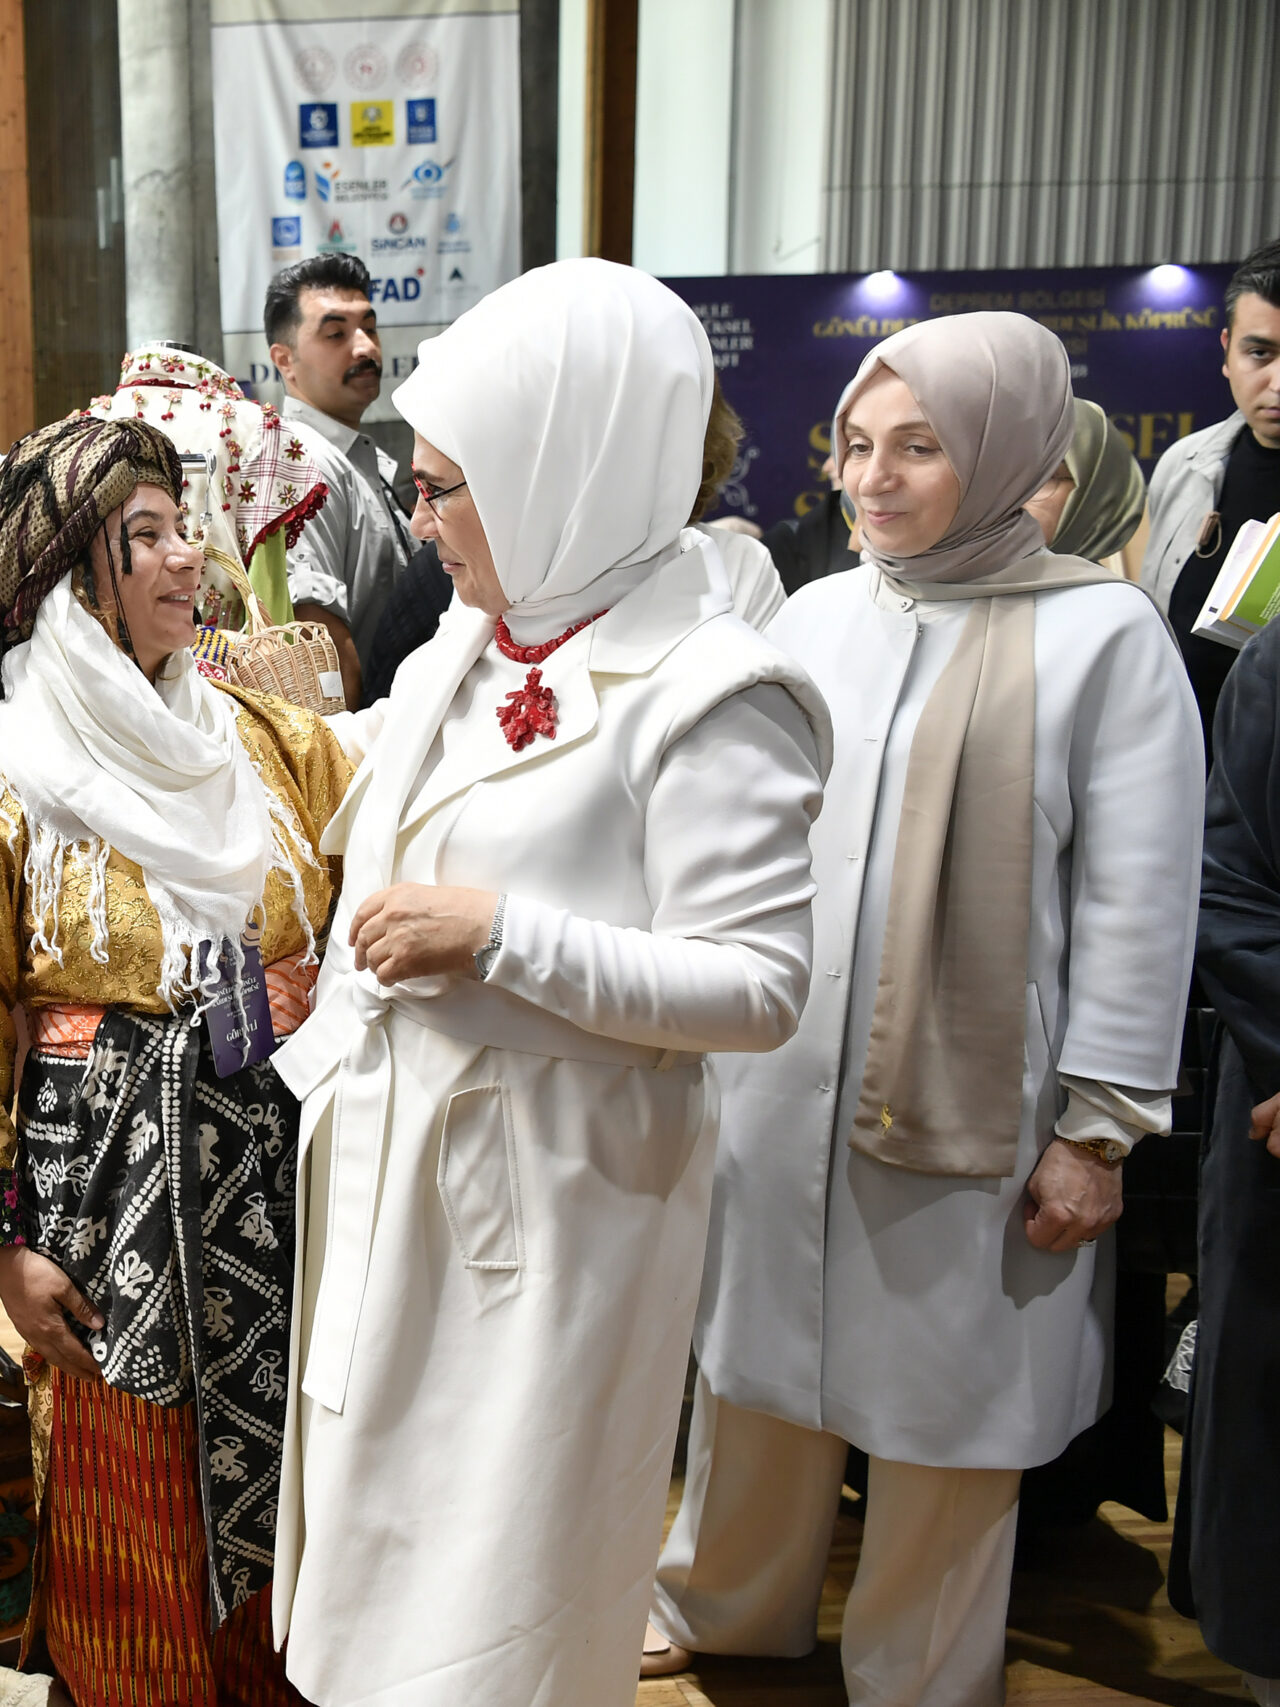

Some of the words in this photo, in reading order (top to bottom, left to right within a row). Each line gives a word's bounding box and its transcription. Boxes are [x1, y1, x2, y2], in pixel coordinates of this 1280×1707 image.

[368, 276, 422, 303] FAD
[702, 319, 754, 334] ÜKSEL
[226, 1018, 258, 1042] GÖRVLİ
